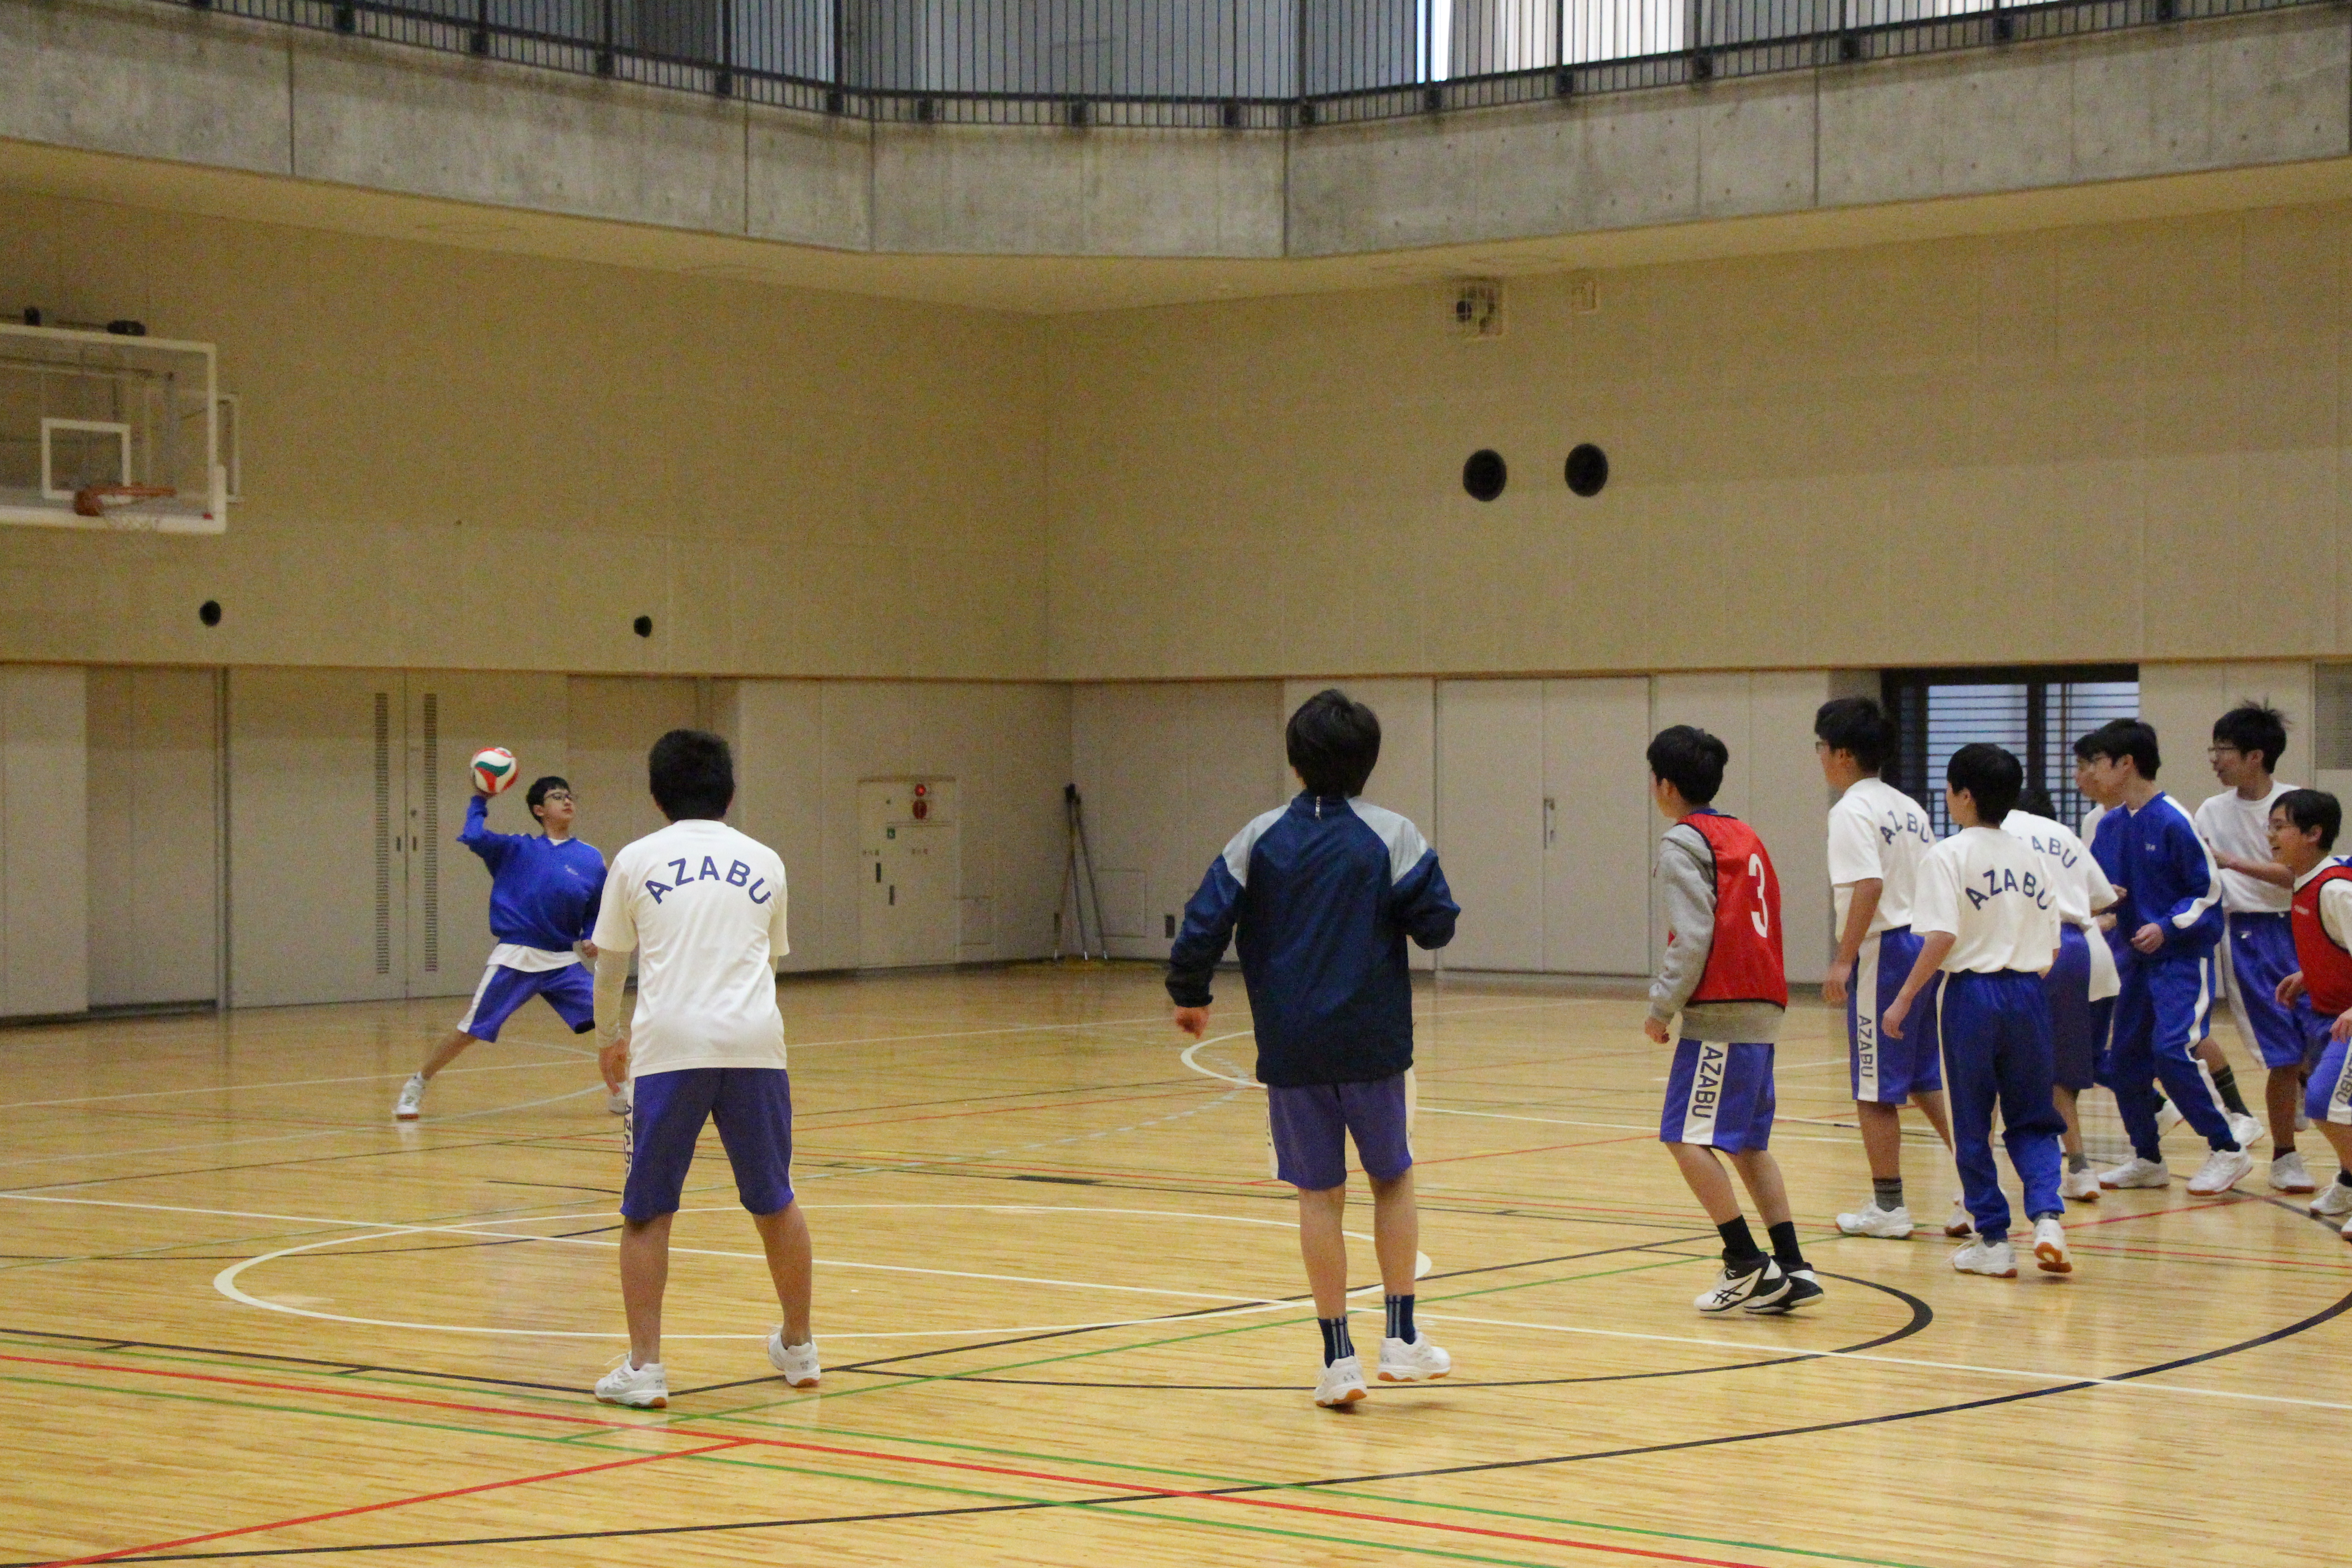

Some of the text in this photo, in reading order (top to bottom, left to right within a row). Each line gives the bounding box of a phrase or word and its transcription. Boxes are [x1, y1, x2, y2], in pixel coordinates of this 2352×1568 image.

[1880, 810, 1929, 845] AZBU
[645, 855, 771, 905] AZABU
[1748, 853, 1769, 938] 3
[1965, 868, 2048, 911] AZABU
[1858, 1015, 1873, 1077] AZABU
[1691, 1045, 1724, 1118] AZABU
